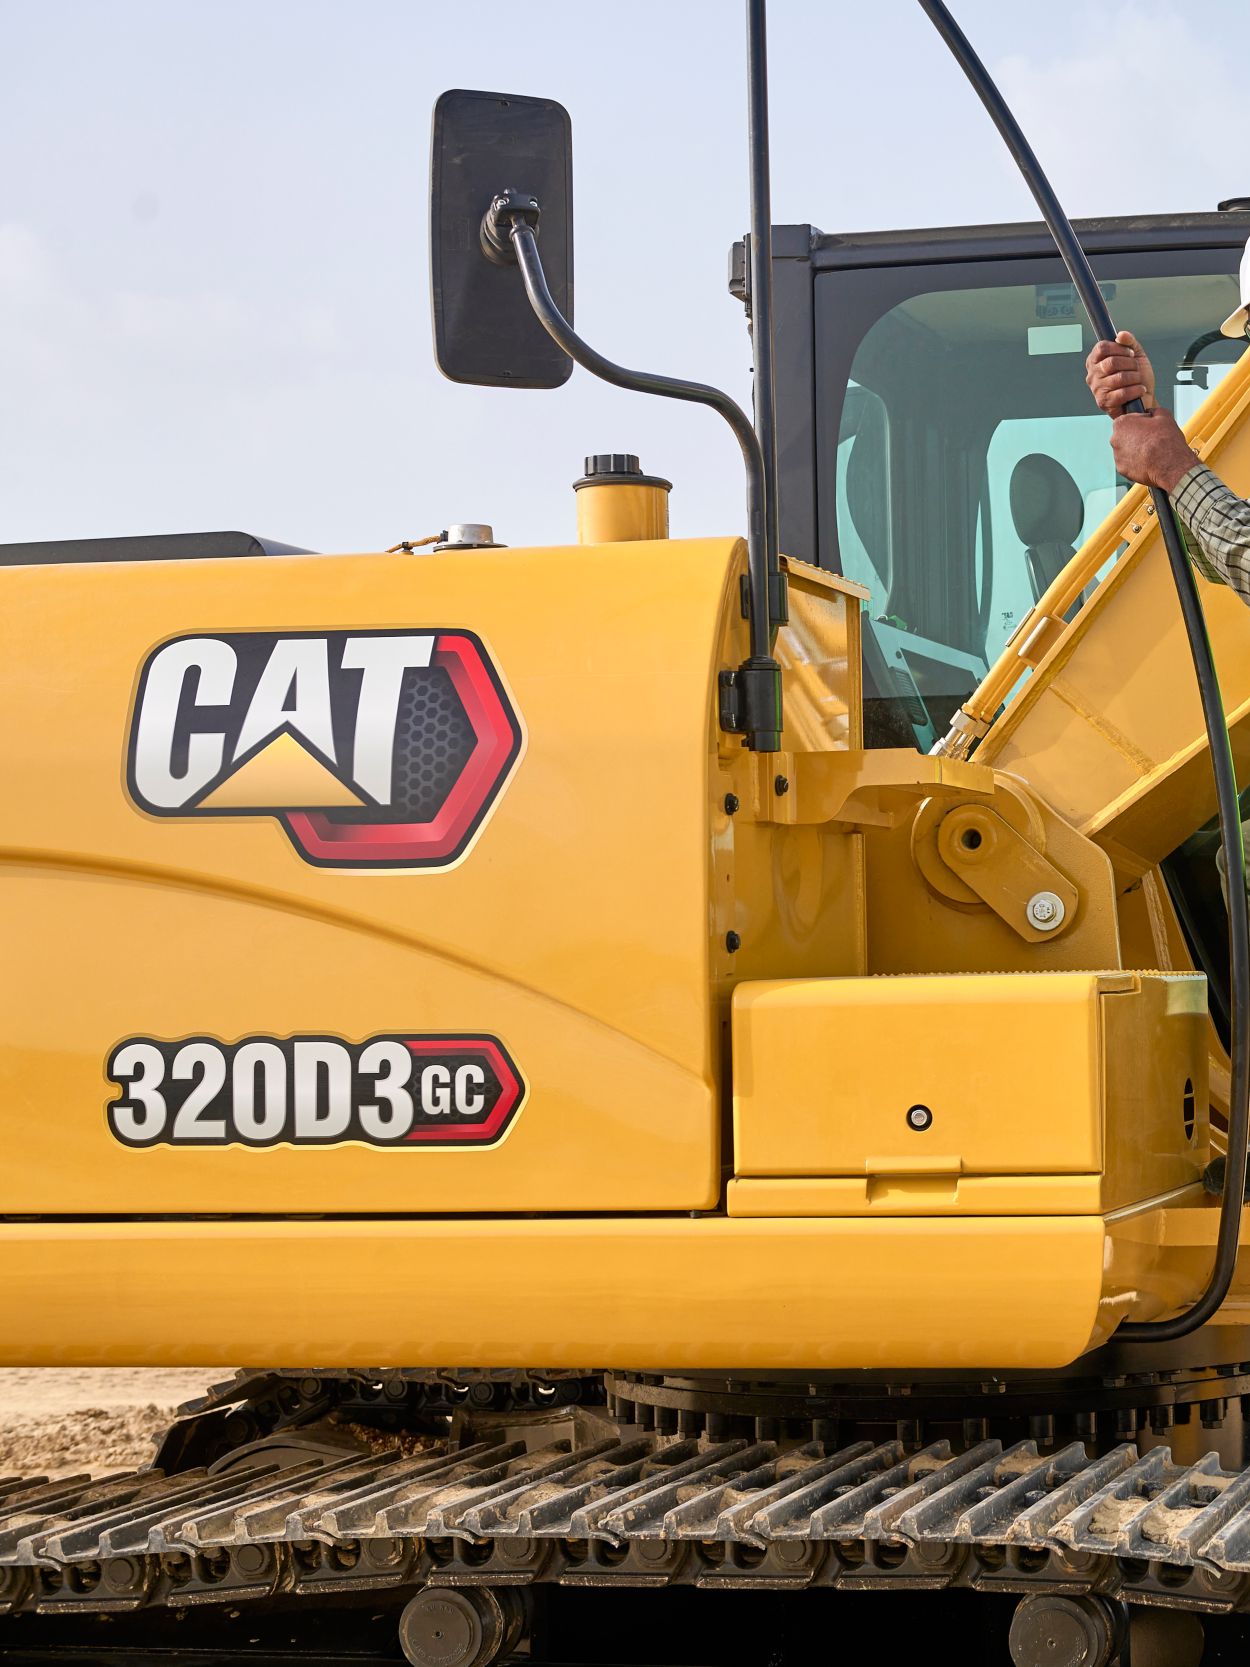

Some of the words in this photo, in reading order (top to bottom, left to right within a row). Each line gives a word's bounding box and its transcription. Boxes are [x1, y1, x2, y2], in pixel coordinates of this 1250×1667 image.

[135, 635, 435, 808] CAT
[113, 1041, 413, 1140] 320D3
[421, 1065, 485, 1115] GC
